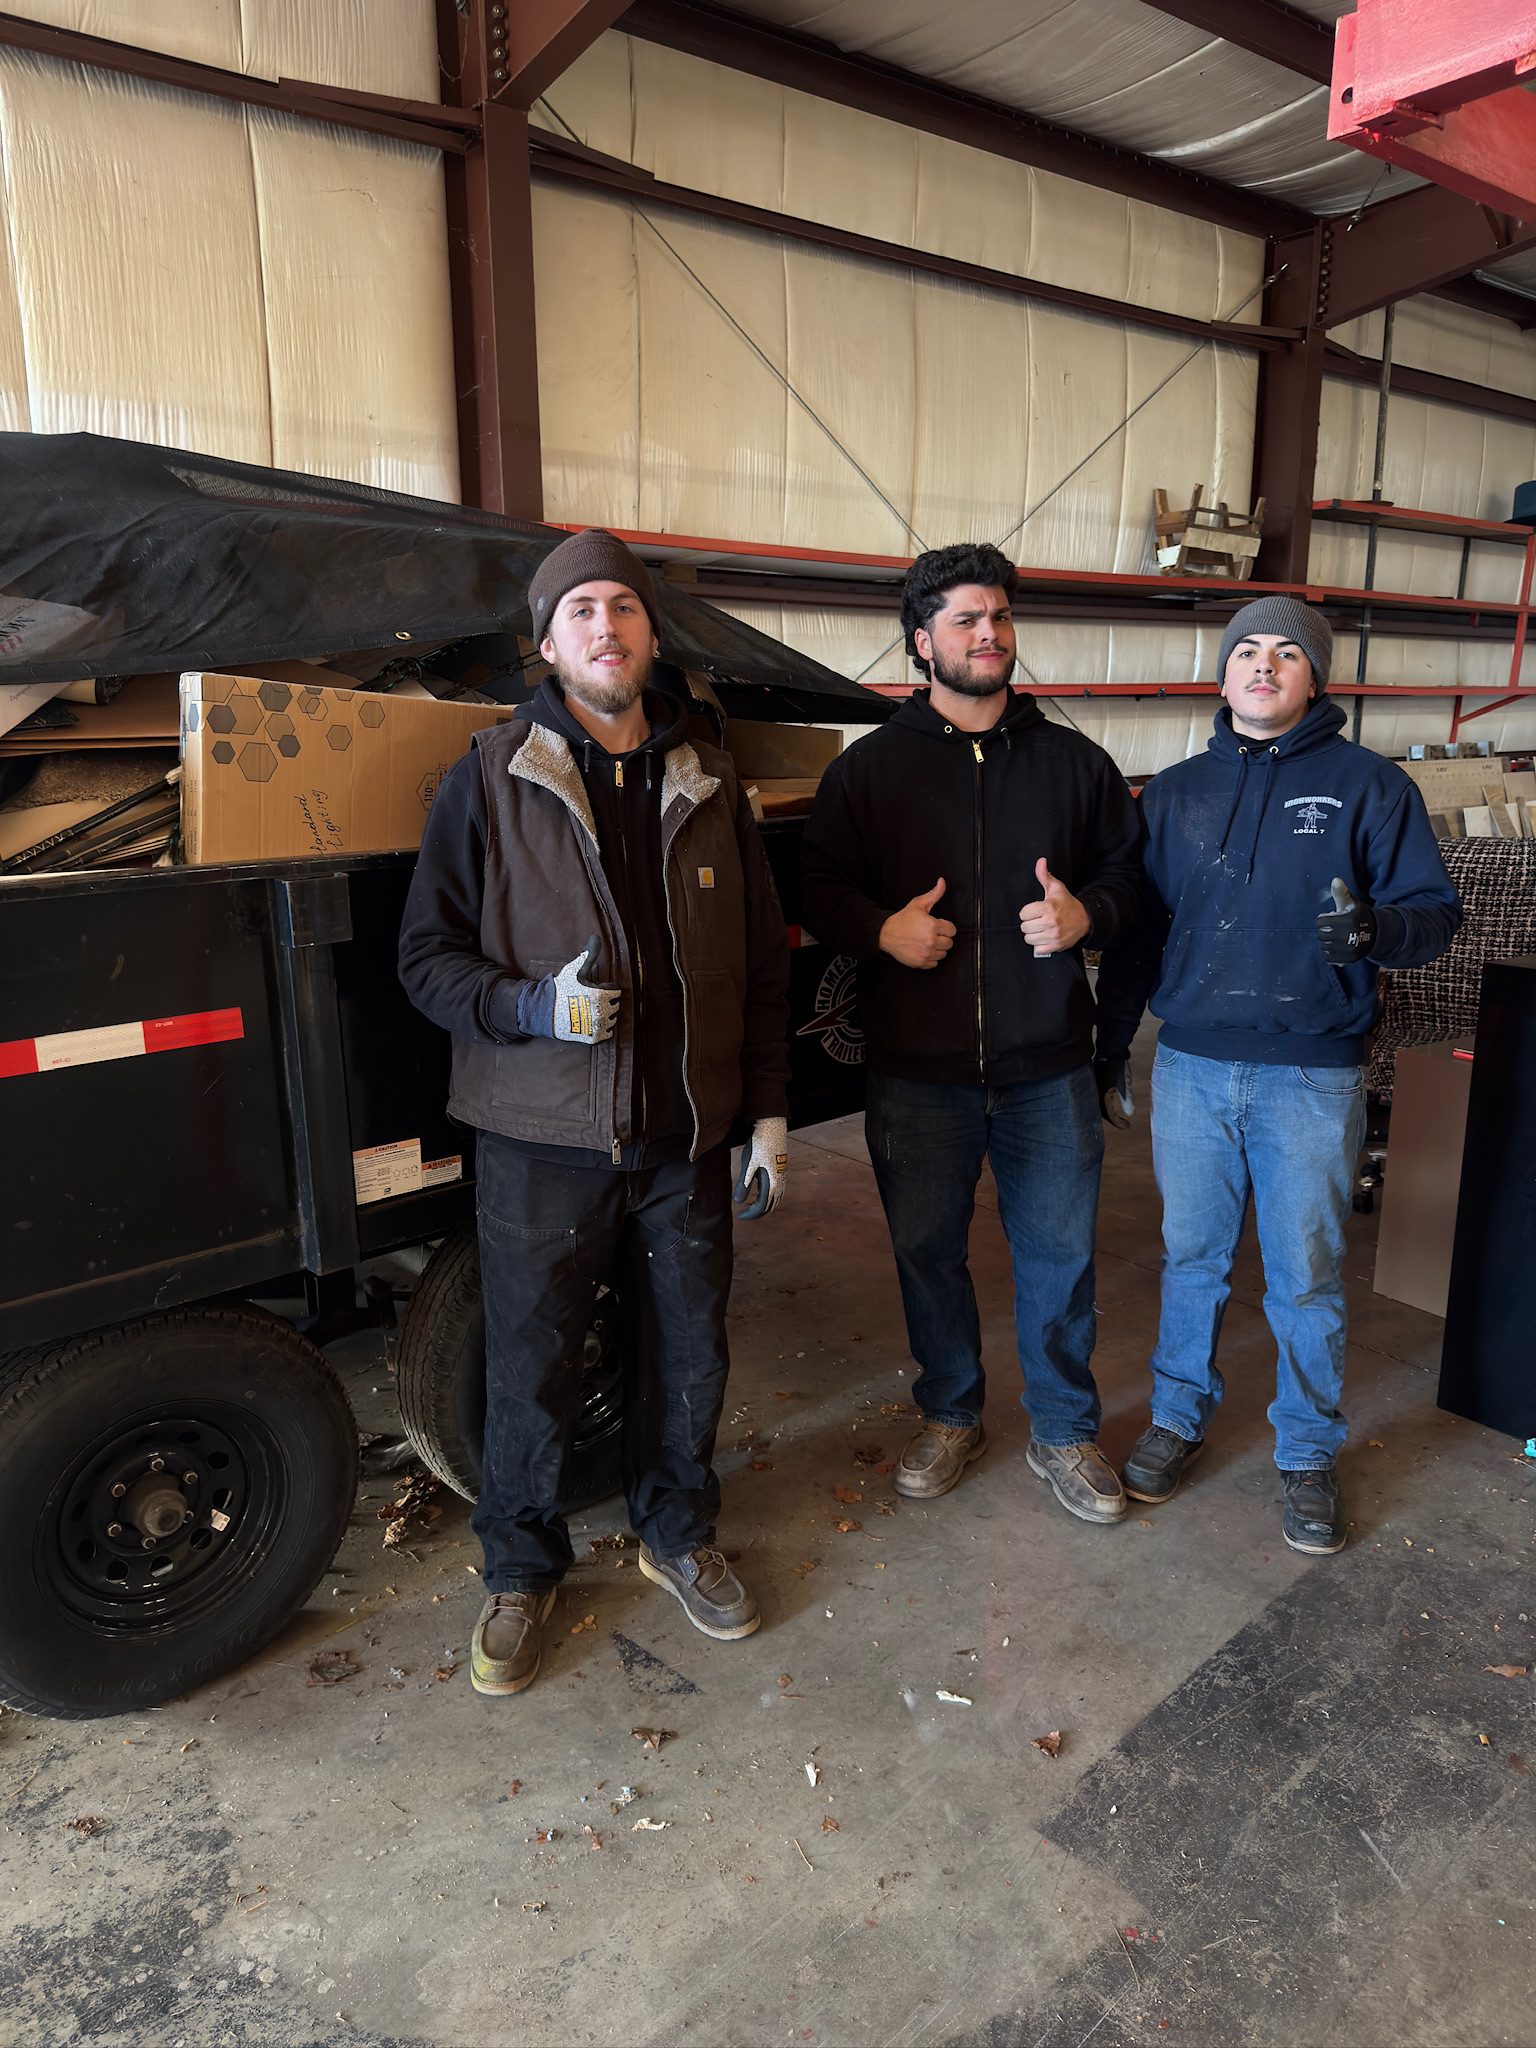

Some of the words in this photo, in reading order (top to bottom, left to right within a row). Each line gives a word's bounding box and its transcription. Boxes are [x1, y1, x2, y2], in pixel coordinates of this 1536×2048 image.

[1283, 796, 1343, 809] IRONWORKERS
[817, 954, 857, 1010] HOMES
[378, 1144, 398, 1152] CAUTION
